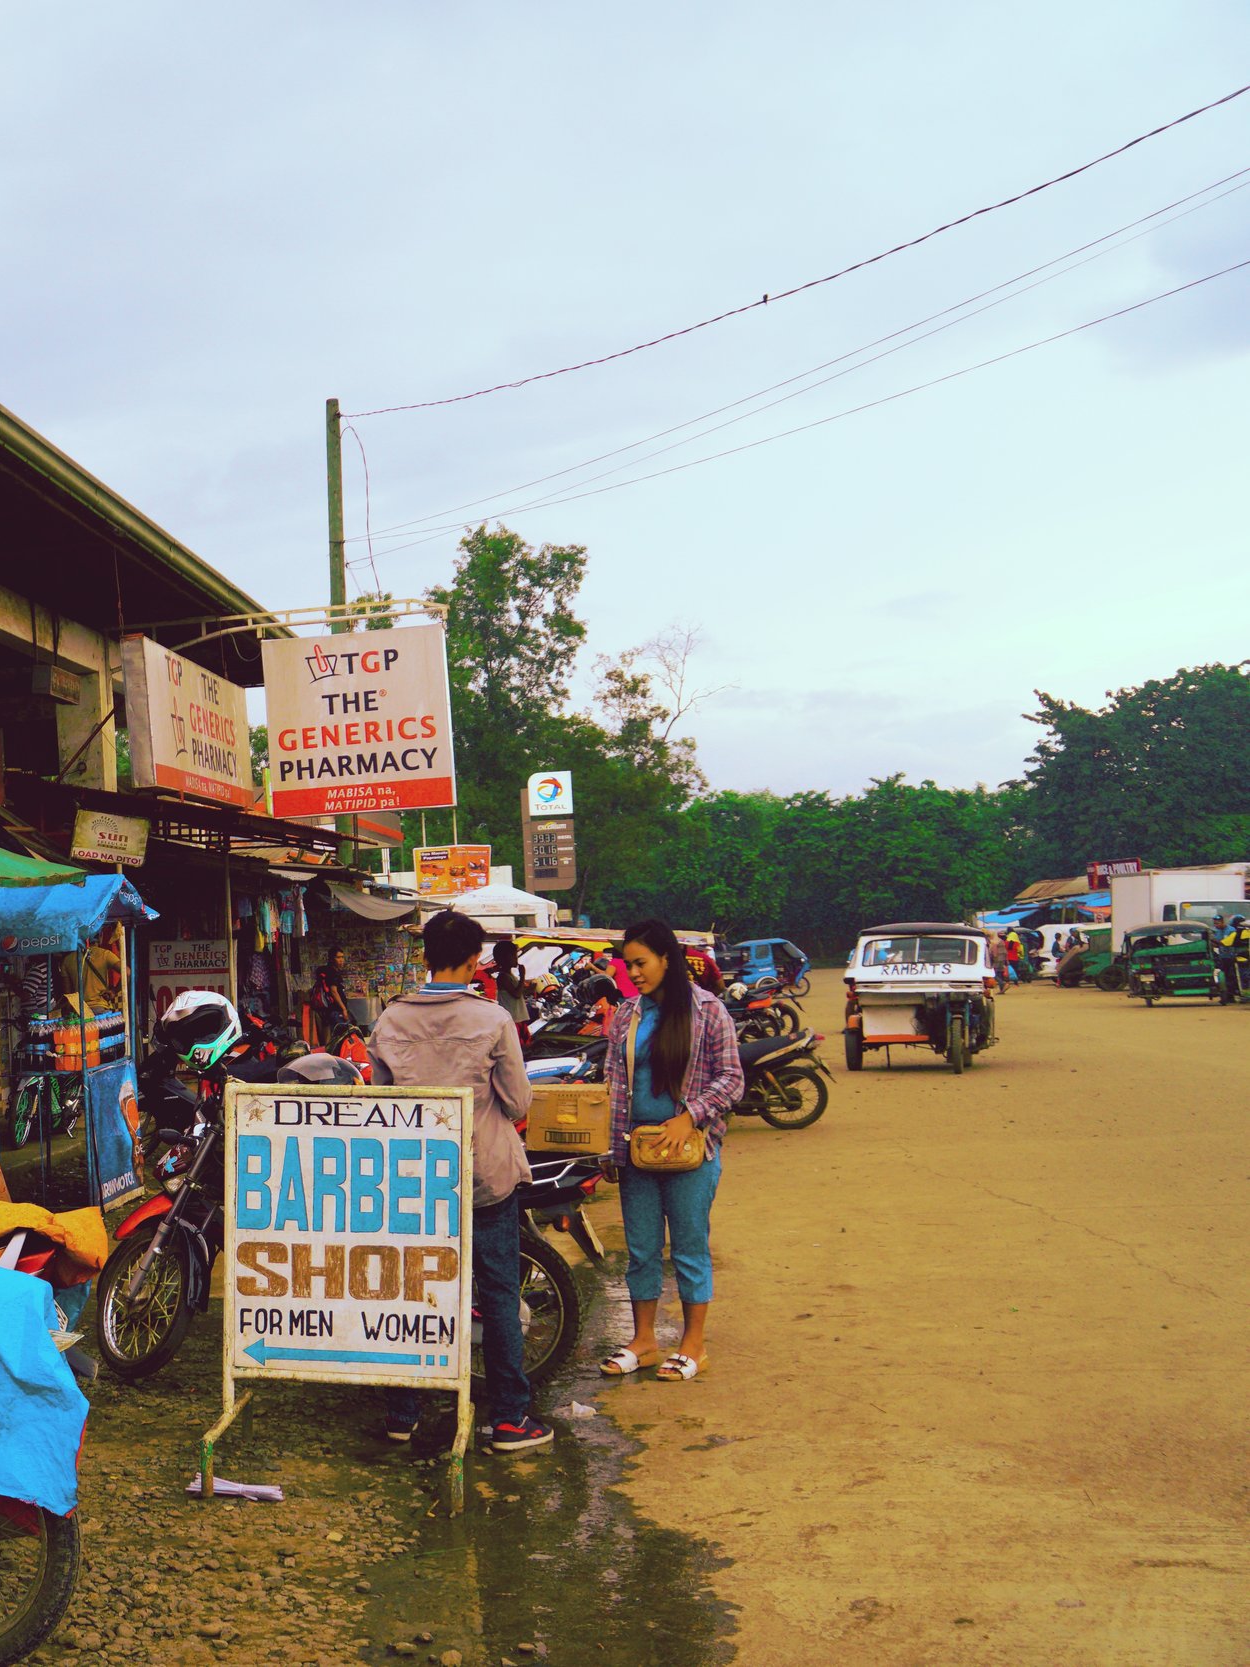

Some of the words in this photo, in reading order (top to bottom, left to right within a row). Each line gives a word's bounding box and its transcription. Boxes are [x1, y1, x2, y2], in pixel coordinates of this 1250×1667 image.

[164, 653, 184, 687] TGP
[340, 648, 399, 675] TGP
[200, 671, 220, 706] THE
[321, 690, 380, 715] THE
[189, 702, 236, 747] GENERICS
[277, 715, 438, 752] GENERICS
[191, 737, 238, 778] PHARMACY
[279, 747, 439, 782] PHARMACY
[324, 798, 377, 811] MATIPID
[380, 796, 400, 809] pa!
[327, 786, 373, 799] MABISA
[377, 786, 396, 796] na,
[534, 803, 568, 811] TOTAL
[101, 853, 114, 861] NA
[116, 856, 141, 865] DITO!
[20, 933, 61, 950] pepsi
[152, 944, 172, 954] TGP
[191, 943, 211, 952] THE
[173, 959, 228, 969] PHARMACY
[174, 951, 227, 961] GENERICS
[273, 1100, 424, 1128] DREAM
[236, 1135, 460, 1238] BARBER
[236, 1241, 459, 1302] SHOP
[239, 1308, 283, 1336] FOR
[289, 1309, 334, 1337] MEN
[361, 1311, 455, 1346] WOMEN
